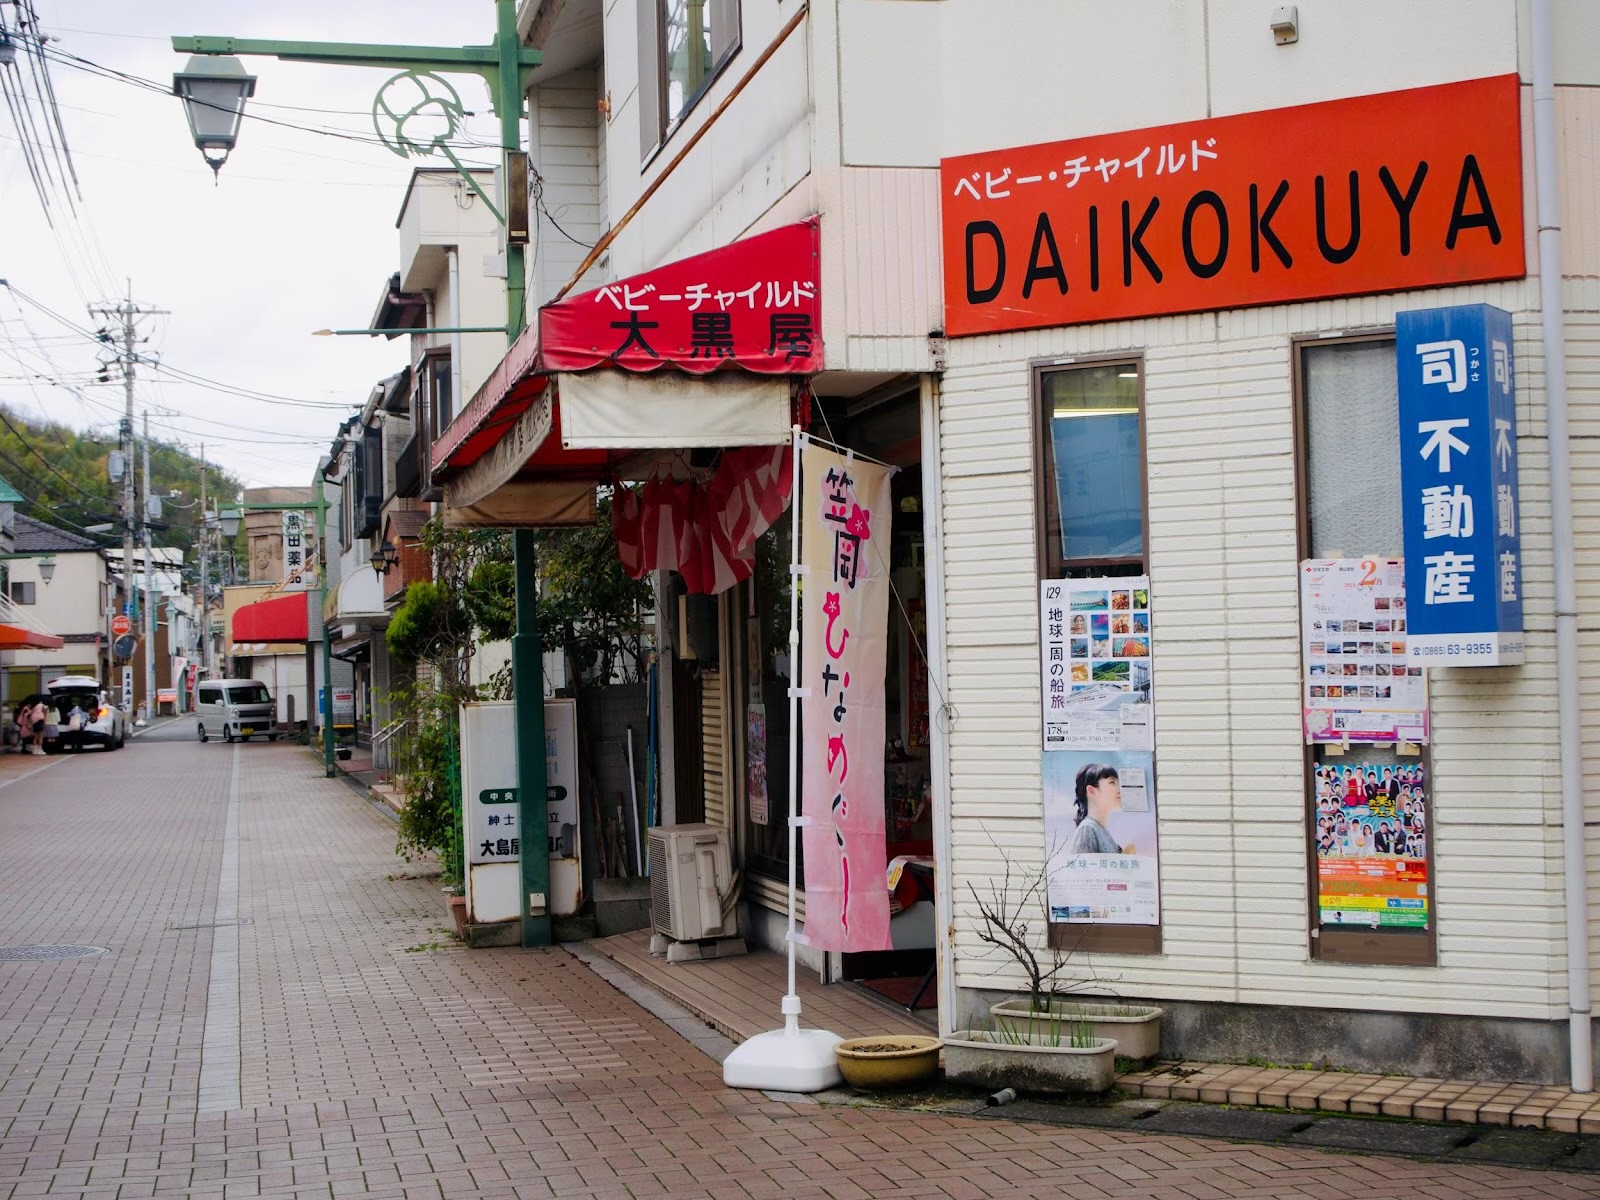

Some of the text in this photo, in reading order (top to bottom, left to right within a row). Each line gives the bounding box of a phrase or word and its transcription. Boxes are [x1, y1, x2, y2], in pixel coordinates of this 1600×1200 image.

[954, 137, 1218, 200] ベビー・チャイルド
[965, 154, 1502, 305] DAIKOKUYA
[594, 280, 815, 312] ベビーチャイルド
[609, 310, 814, 364] 大黒屋
[1469, 346, 1480, 382] つかさ
[1415, 339, 1475, 605] 司不動産
[1492, 339, 1517, 602] 司不動産
[1046, 586, 1061, 599] 129
[1048, 607, 1065, 709] 地球一周の船旅
[1447, 643, 1493, 655] 63-9355
[489, 789, 557, 801] 中央街
[1066, 859, 1140, 870] 地球一周の船旅
